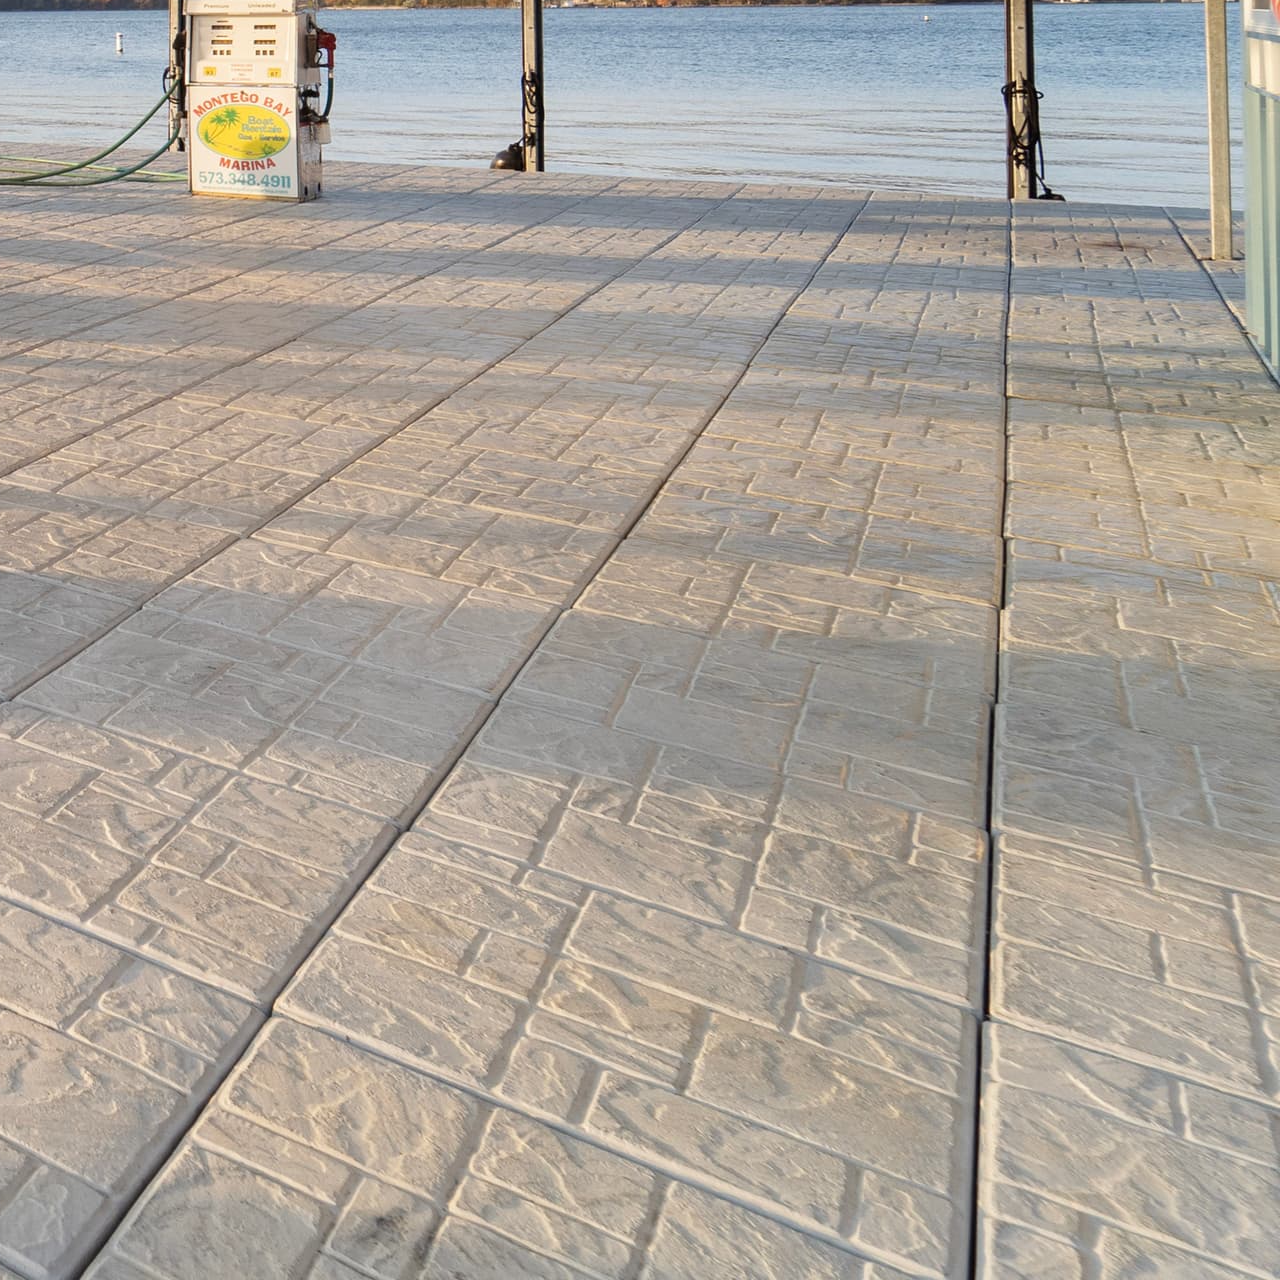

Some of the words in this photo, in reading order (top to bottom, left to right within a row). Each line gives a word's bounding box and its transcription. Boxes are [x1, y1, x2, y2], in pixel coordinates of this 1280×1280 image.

[193, 93, 259, 117] MONTEGO
[263, 97, 293, 117] BAY
[248, 115, 274, 125] Boat
[219, 157, 276, 171] MARINA
[199, 171, 291, 188] 573.348.4911
